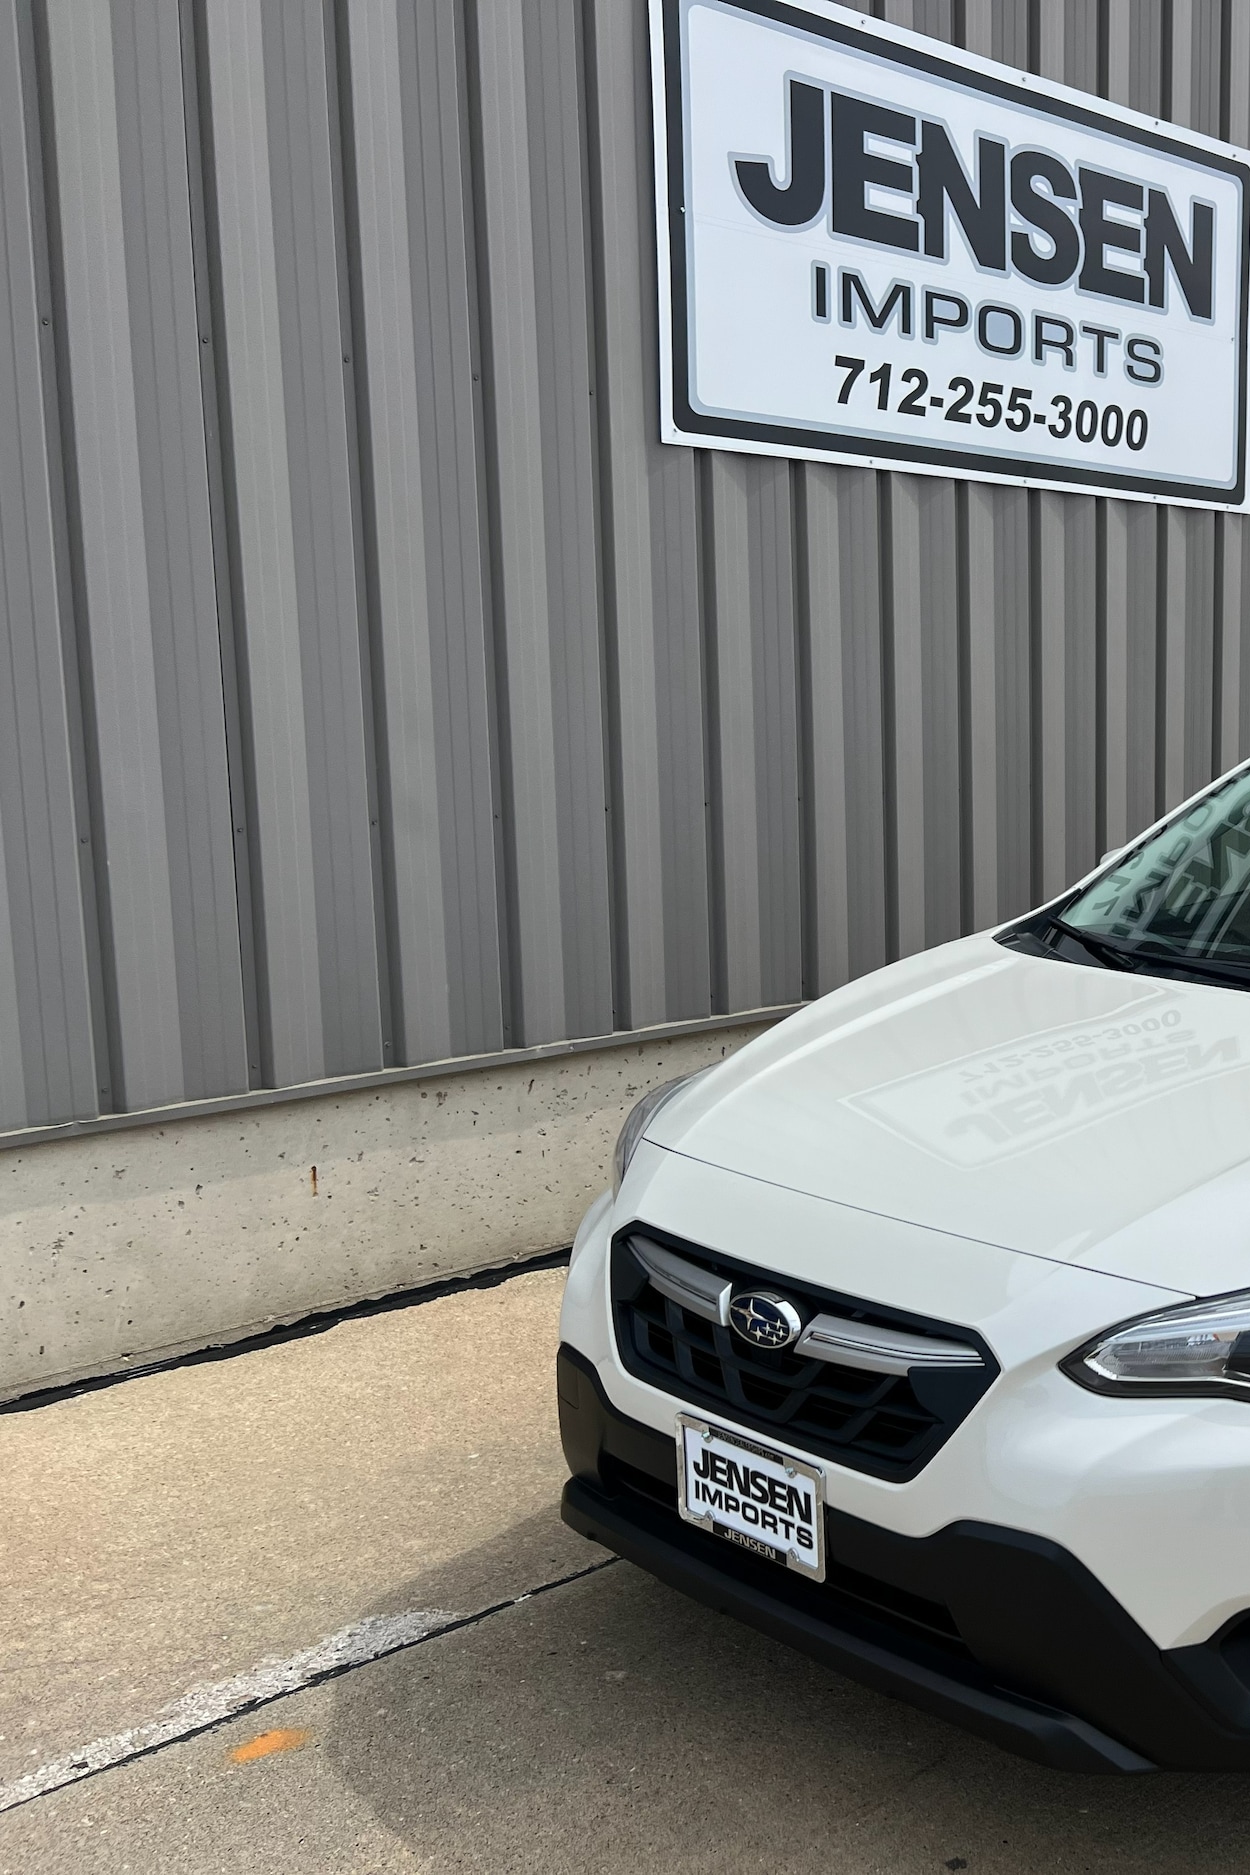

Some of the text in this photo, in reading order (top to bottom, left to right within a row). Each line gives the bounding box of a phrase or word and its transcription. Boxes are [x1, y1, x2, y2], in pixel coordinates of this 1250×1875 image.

[733, 76, 1215, 322] JENSEN
[813, 264, 1163, 385] IMPORTS
[833, 354, 1149, 452] 712-255-3000
[693, 1448, 813, 1526] JENSEN
[694, 1480, 813, 1550] IMPORTS
[724, 1528, 777, 1560] JENSEN
